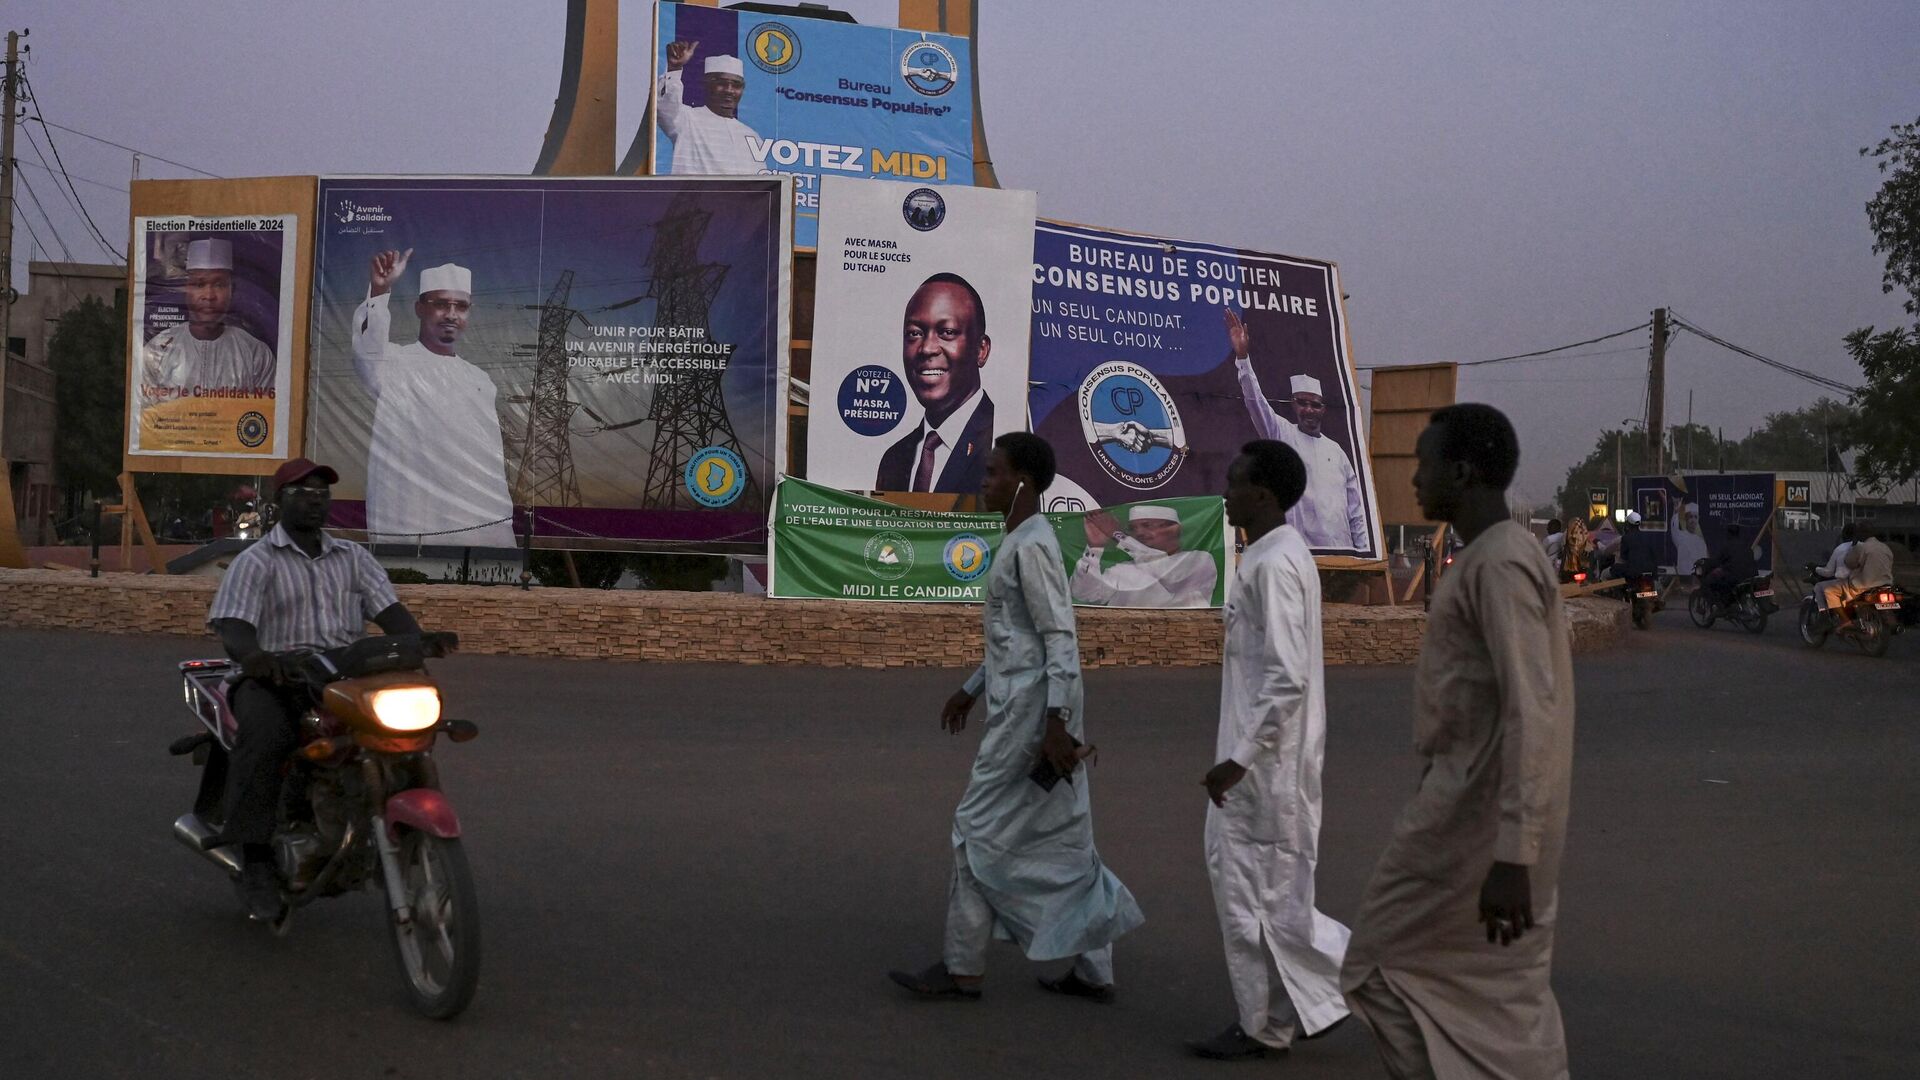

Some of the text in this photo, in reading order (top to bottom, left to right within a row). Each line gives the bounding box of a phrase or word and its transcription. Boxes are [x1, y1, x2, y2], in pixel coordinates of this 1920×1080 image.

[920, 52, 940, 66] CP
[838, 77, 891, 95] Bureau
[744, 135, 947, 181] VOTEZ MIDI
[357, 205, 384, 213] Avenir
[355, 213, 392, 222] Solidaire
[146, 219, 284, 231] Election Présidentielle 2024
[844, 237, 898, 249] AVEC MASRA
[844, 249, 911, 263] POUR LE SUCCÈS
[843, 262, 886, 273] DU TCHAD
[1069, 244, 1281, 288] BUREAU DE SOUTIEN
[1032, 263, 1318, 317] CONSENSUS POPULAIRE
[1031, 298, 1186, 330] UN SEUL CANDIDAT.
[587, 325, 705, 338] "UNIR POUR BÂTIR
[1040, 321, 1061, 338] UN
[1068, 325, 1108, 344] SEUL
[1113, 331, 1163, 350] CHOIX
[565, 340, 731, 354] UN AVENIR ÉNERGÉTIQUE
[568, 356, 727, 370] DURABLE ET ACCESSIBLE
[605, 373, 683, 385] AVEC MIDI."
[857, 370, 892, 379] VOTEZ LE
[193, 385, 249, 399] Candidat
[1080, 365, 1180, 428] CONSENSUS POPULAIRE
[853, 399, 891, 409] MASRA
[1111, 386, 1144, 416] CP
[844, 408, 899, 420] PRÉSIDENT
[1097, 449, 1179, 484] UNITE VOLONTE SUCCES
[1592, 493, 1606, 501] CAT
[1718, 493, 1732, 501] SEUL
[1787, 486, 1809, 501] CAT
[791, 505, 826, 514] VOTEZ
[828, 506, 849, 515] MIDI
[851, 507, 882, 517] POUR
[883, 508, 898, 517] LA
[1728, 501, 1764, 509] ENGAGEMENT
[785, 516, 800, 525] DE
[802, 517, 833, 525] L'EAU
[835, 518, 848, 526] ET
[851, 519, 873, 527] UNE
[875, 518, 934, 529] ÉDUCATION
[936, 521, 951, 529] DE
[953, 520, 997, 529] QUALITÉ
[842, 584, 982, 598] MIDI LE CANDIDAT
